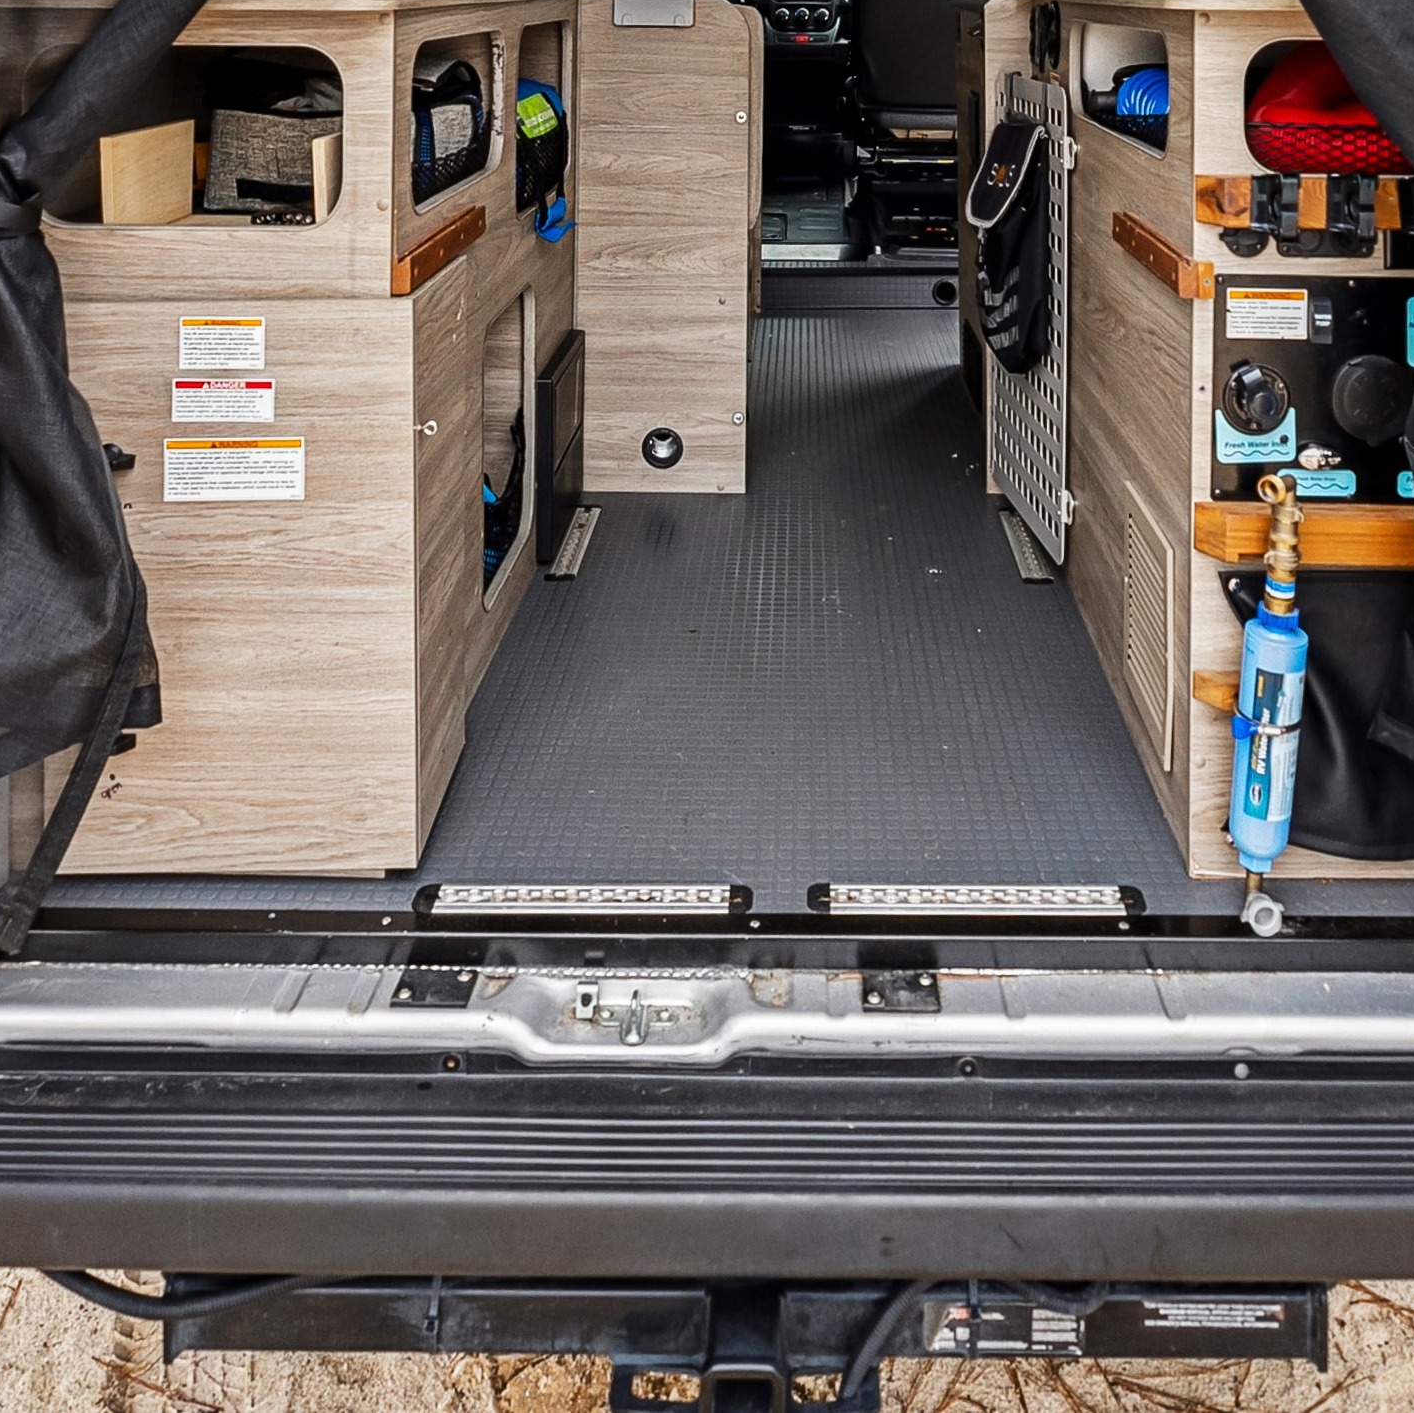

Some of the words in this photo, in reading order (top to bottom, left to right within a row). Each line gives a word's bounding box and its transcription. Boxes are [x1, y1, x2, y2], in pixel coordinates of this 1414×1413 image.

[210, 381, 247, 390] DANGER
[1224, 441, 1246, 449] Fresh
[1247, 440, 1270, 448] Water
[1257, 735, 1269, 760] Wate
[1256, 760, 1266, 775] RV
